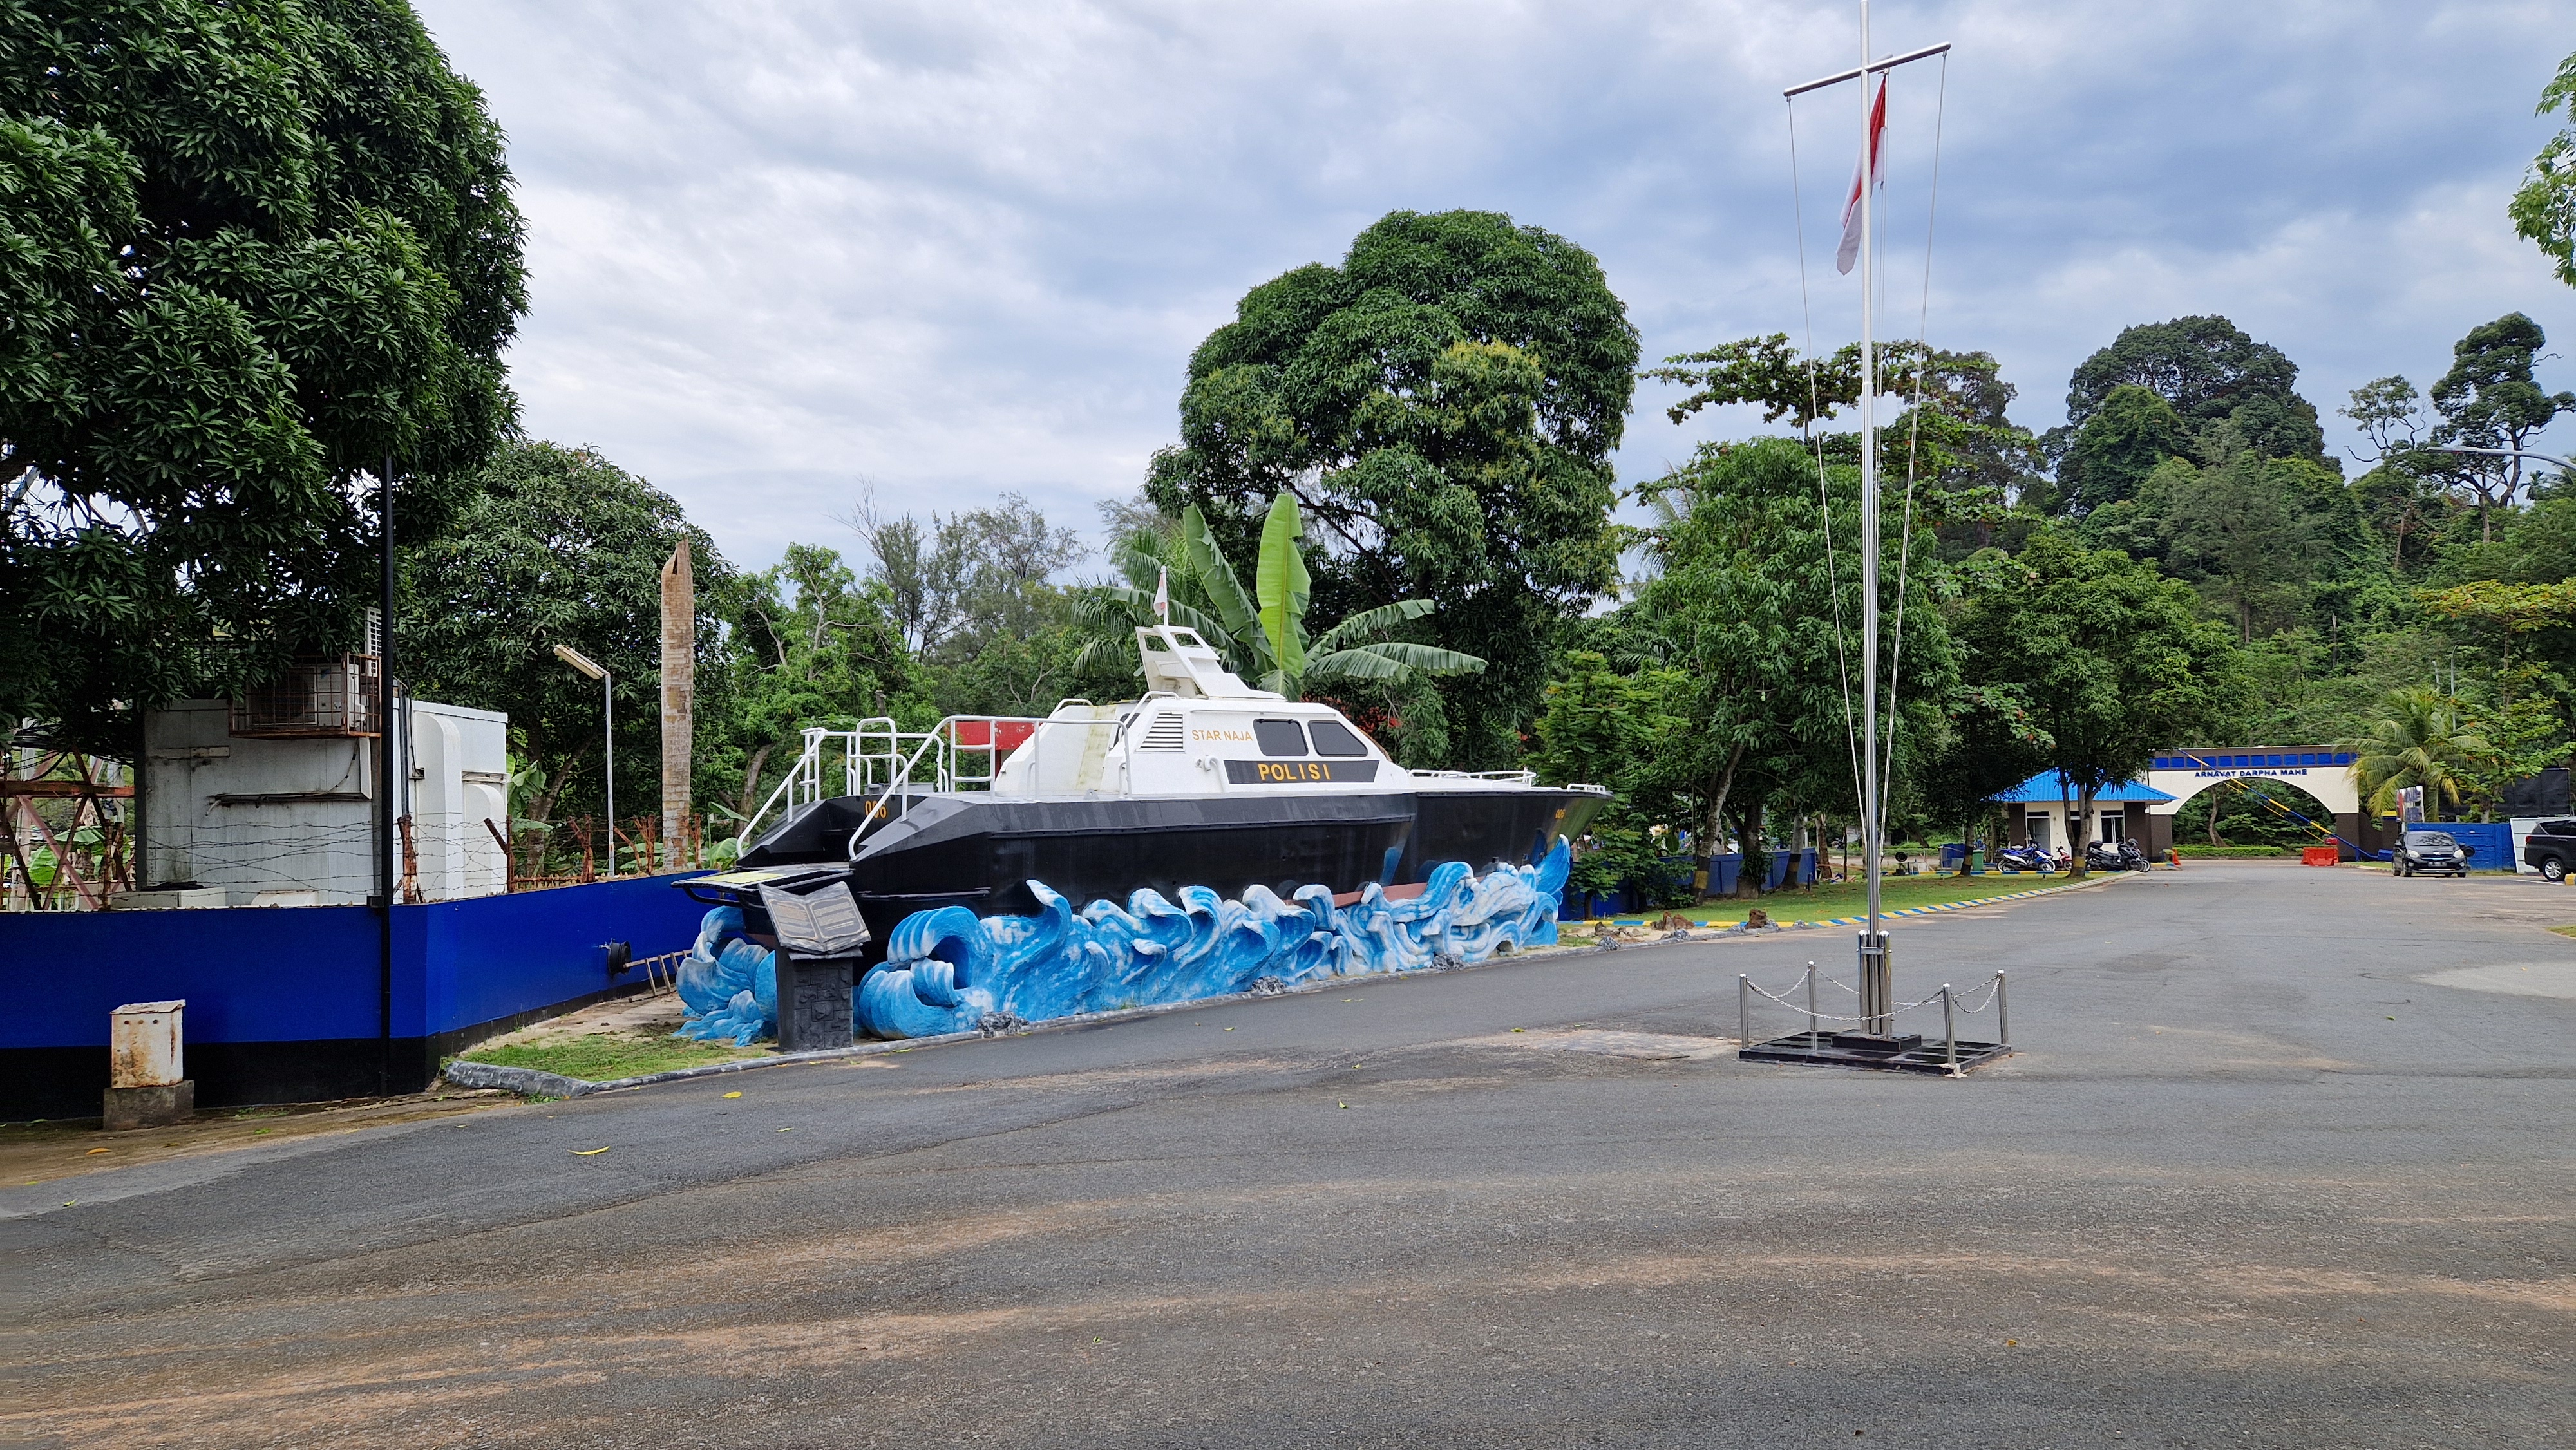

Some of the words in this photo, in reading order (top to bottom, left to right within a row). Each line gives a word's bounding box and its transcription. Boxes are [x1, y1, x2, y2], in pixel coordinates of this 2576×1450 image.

[1191, 730, 1222, 740] STAR
[1223, 730, 1253, 741] NAJA
[1258, 763, 1331, 780] POLISI
